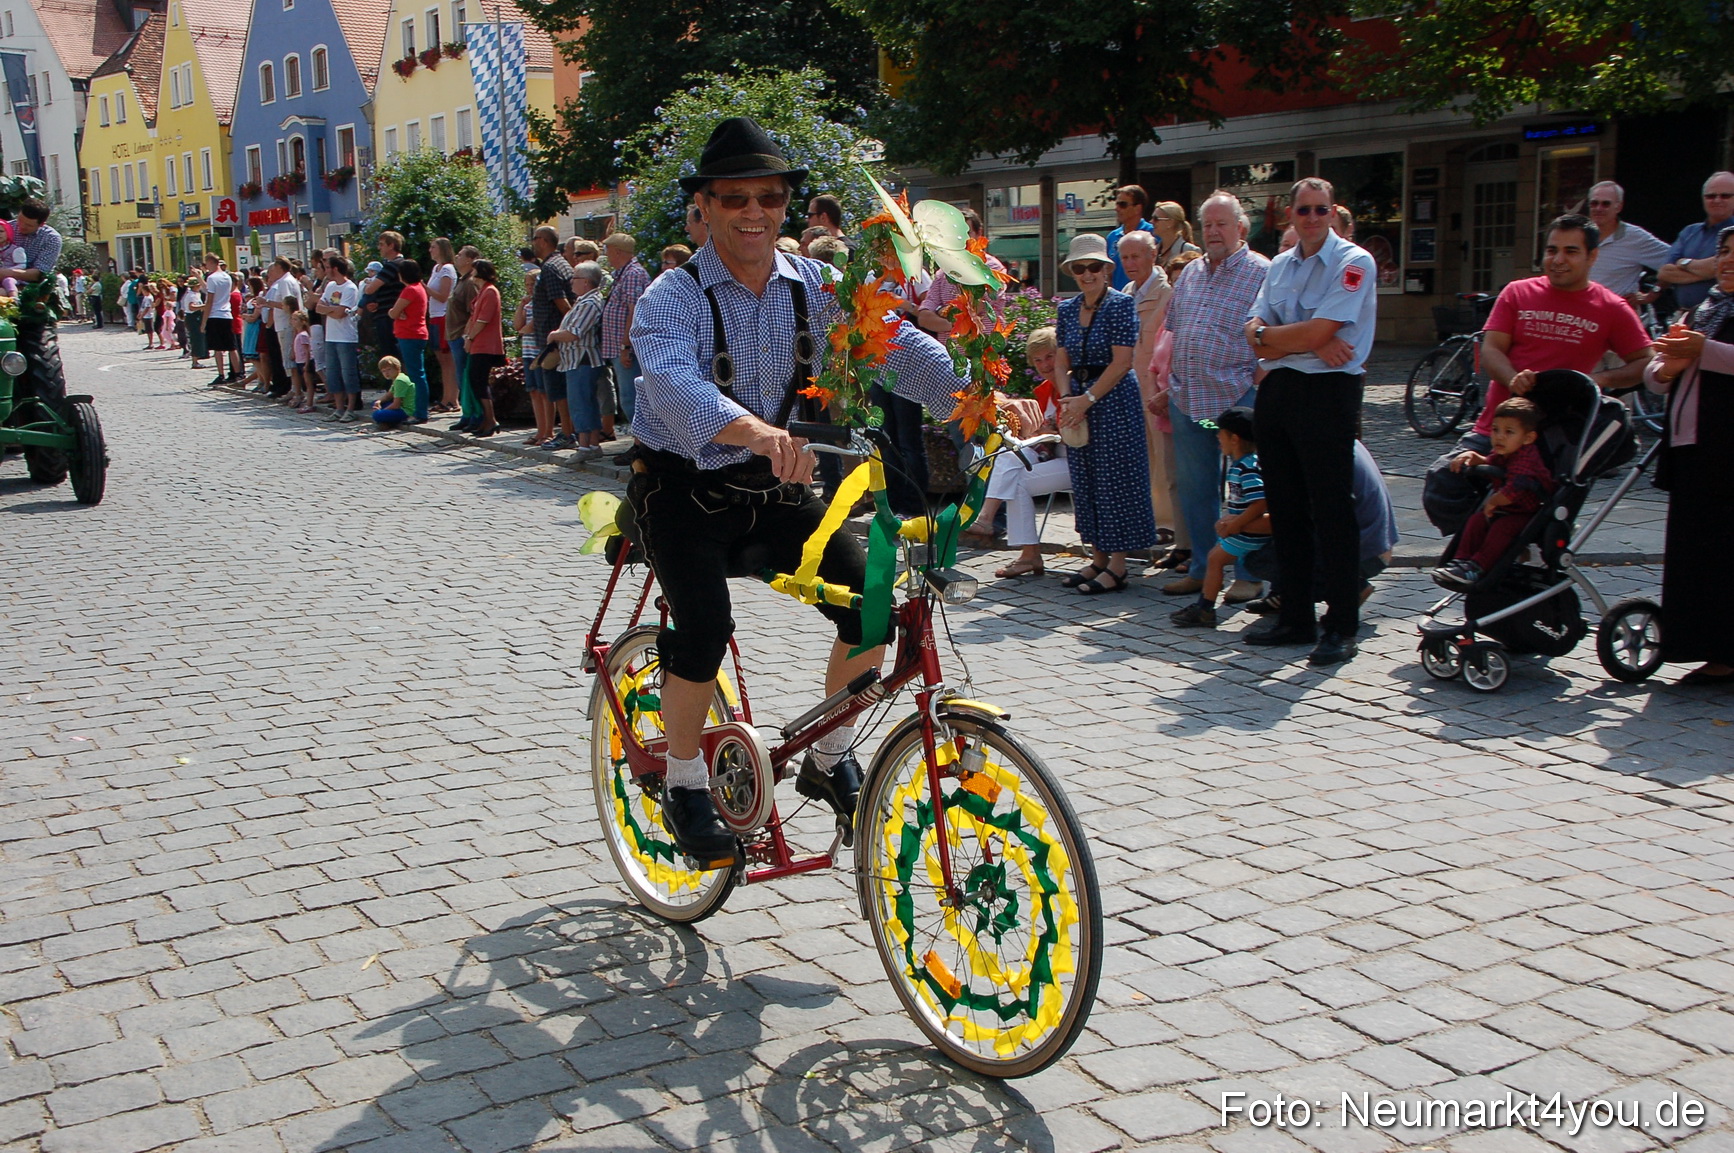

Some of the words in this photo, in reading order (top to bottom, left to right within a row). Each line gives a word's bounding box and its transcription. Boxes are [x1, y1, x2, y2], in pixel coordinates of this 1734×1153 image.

[111, 142, 131, 160] HOTEL
[116, 219, 142, 231] Restaurant
[1517, 310, 1556, 321] DENIM
[1556, 313, 1600, 333] BRAND
[817, 703, 850, 728] HERCULES
